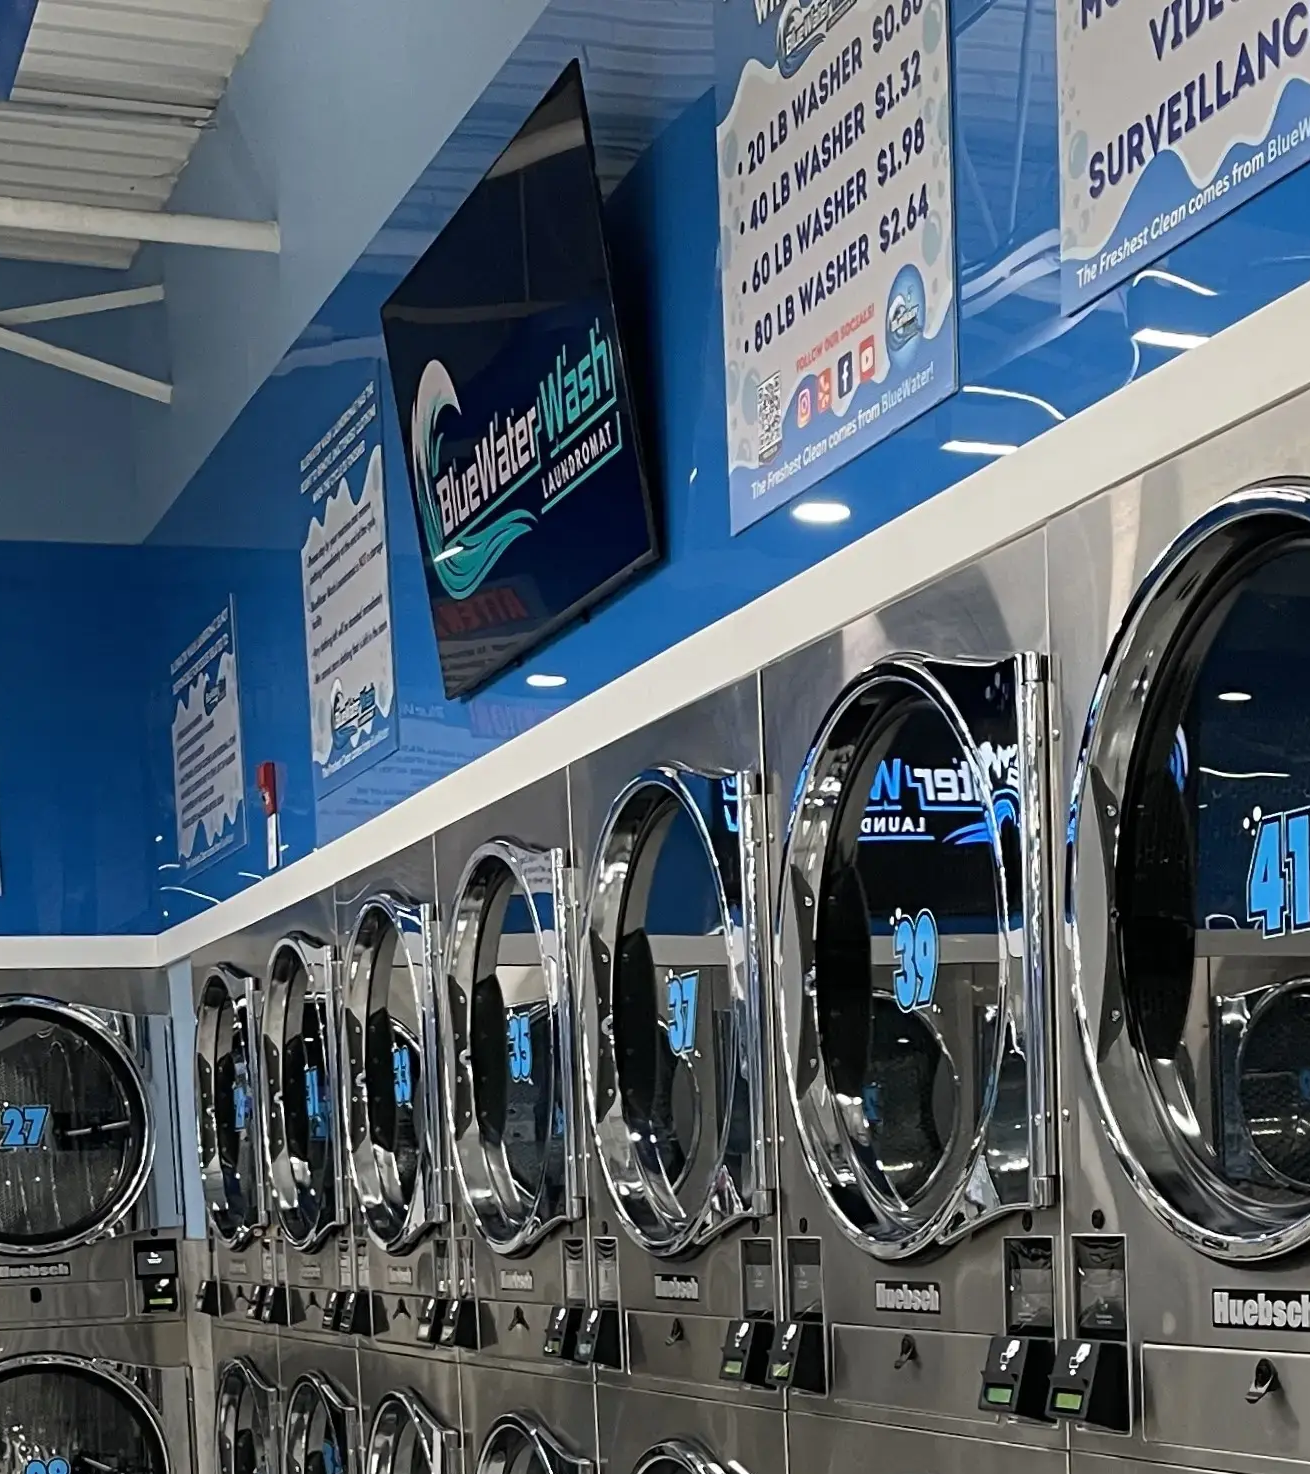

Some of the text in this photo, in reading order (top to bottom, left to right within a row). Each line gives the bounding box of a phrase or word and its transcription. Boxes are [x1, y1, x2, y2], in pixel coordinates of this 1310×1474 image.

[748, 131, 765, 175] 20
[770, 110, 788, 153] LB
[792, 37, 862, 128] WASHER
[750, 50, 921, 231] 40 LB WASHER $1.32
[752, 117, 925, 292] 60 LB WASHER $1.98
[1076, 266, 1098, 288] The
[1099, 226, 1149, 275] Freshest
[1150, 205, 1186, 239] Clean
[1188, 176, 1230, 214] comes
[1232, 150, 1265, 185] from
[755, 183, 929, 352] 80 LB WASHER $2.64
[436, 405, 536, 537] BlueWater
[540, 320, 611, 442] Wash
[882, 361, 934, 414] BlueWater!
[541, 421, 612, 499] LAUNDROMAT
[666, 974, 698, 1051] 37
[894, 912, 938, 1008] 39
[508, 1017, 532, 1079] 35
[2, 1107, 47, 1146] 27
